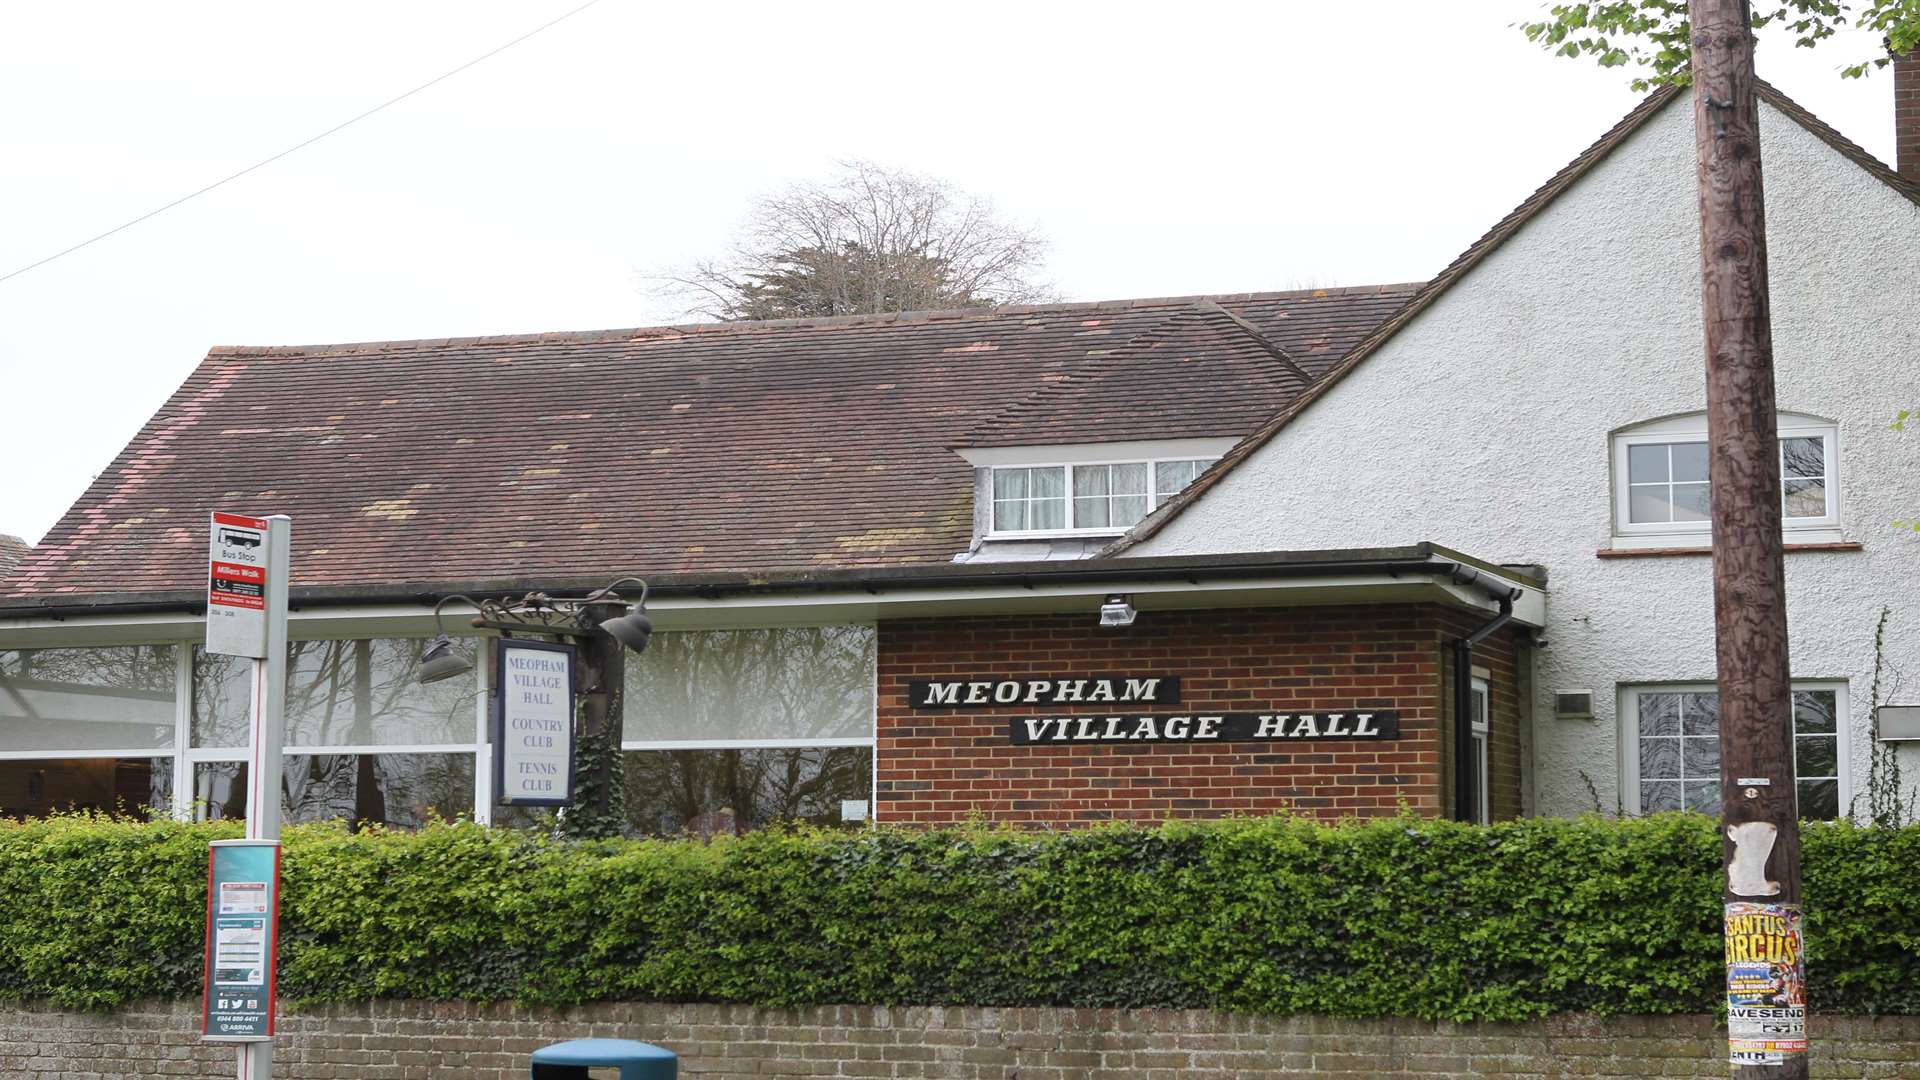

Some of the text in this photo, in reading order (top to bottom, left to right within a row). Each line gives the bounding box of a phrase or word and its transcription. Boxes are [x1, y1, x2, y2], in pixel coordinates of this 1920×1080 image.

[222, 549, 256, 563] Bus Stop
[216, 566, 260, 578] Millers Walk
[509, 656, 566, 673] MEOPHAM
[513, 674, 561, 689] VILLAGE
[523, 691, 553, 705] HALL
[923, 678, 1162, 705] MEOPHAM
[511, 718, 564, 732] COUNTRY
[1023, 713, 1382, 742] VILLAGE HALL
[523, 735, 553, 748] CLUB
[518, 762, 558, 775] TENNIS
[522, 779, 552, 791] CLUB
[1727, 914, 1787, 937] SANTUS
